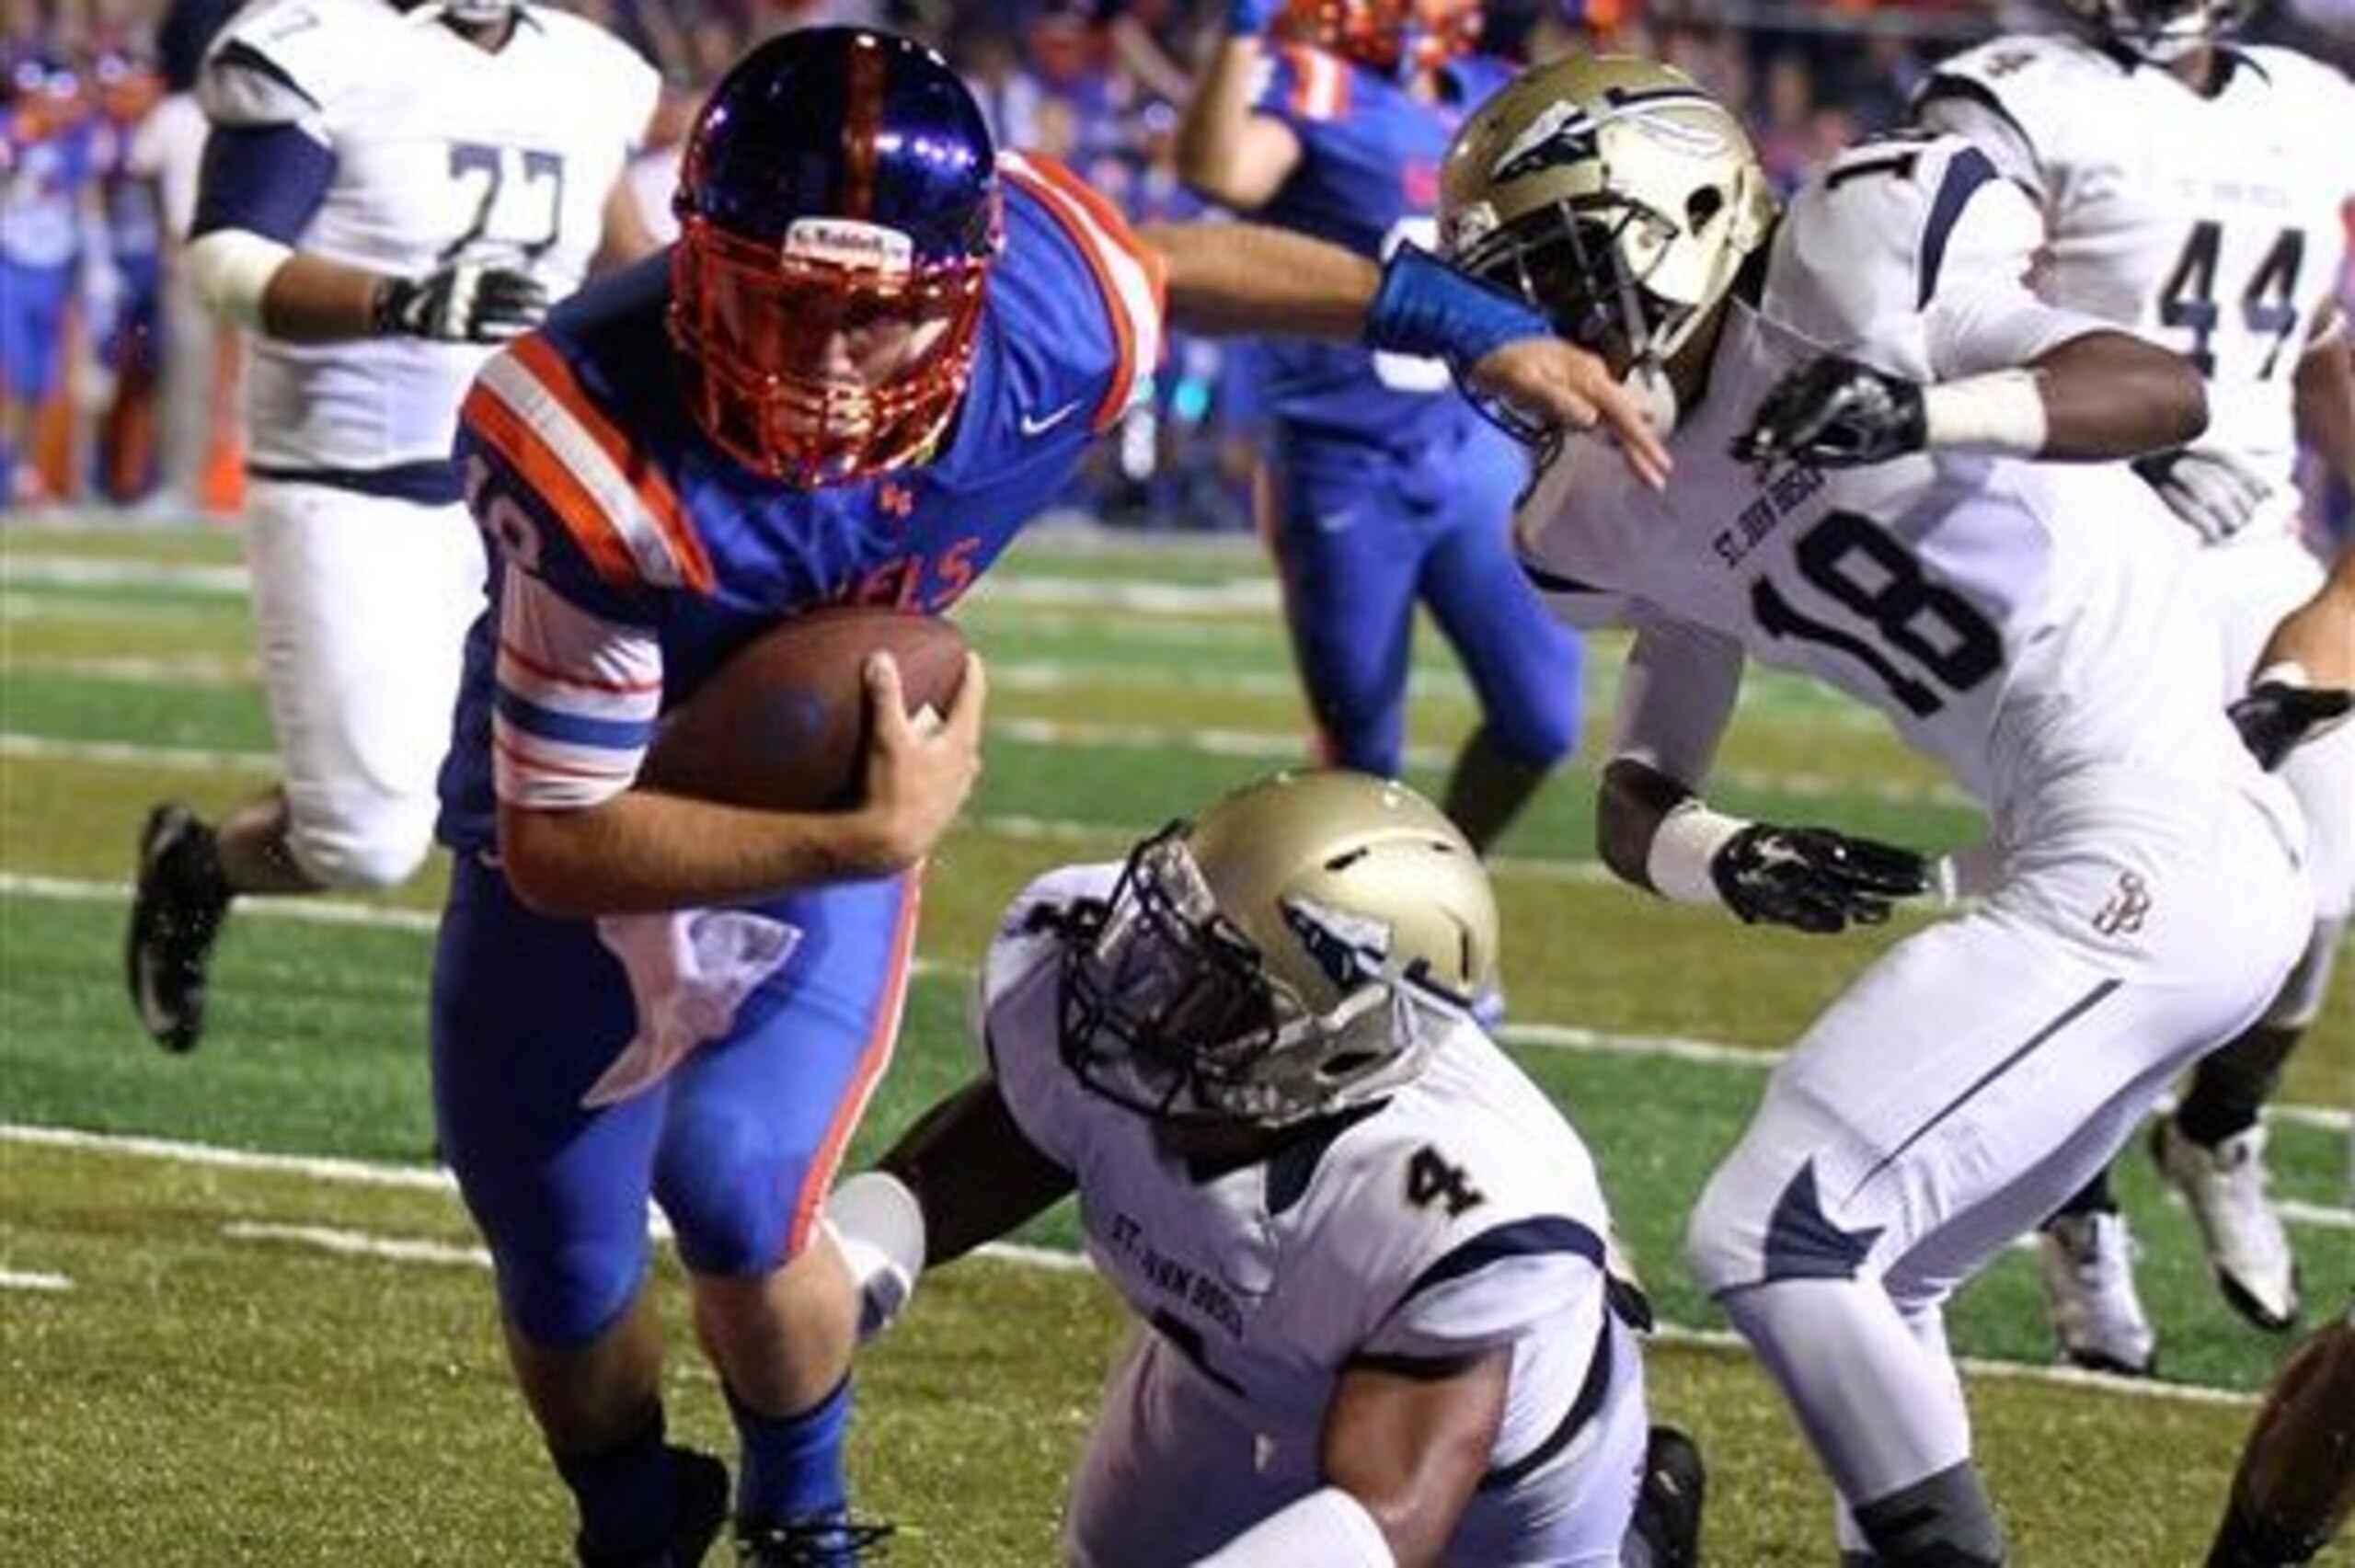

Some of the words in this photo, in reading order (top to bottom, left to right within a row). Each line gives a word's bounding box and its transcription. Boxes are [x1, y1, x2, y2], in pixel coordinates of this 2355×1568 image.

[2158, 219, 2305, 382] 44
[854, 536, 982, 622] ELS
[1750, 508, 2005, 720] 18
[1405, 1143, 1487, 1220] 4
